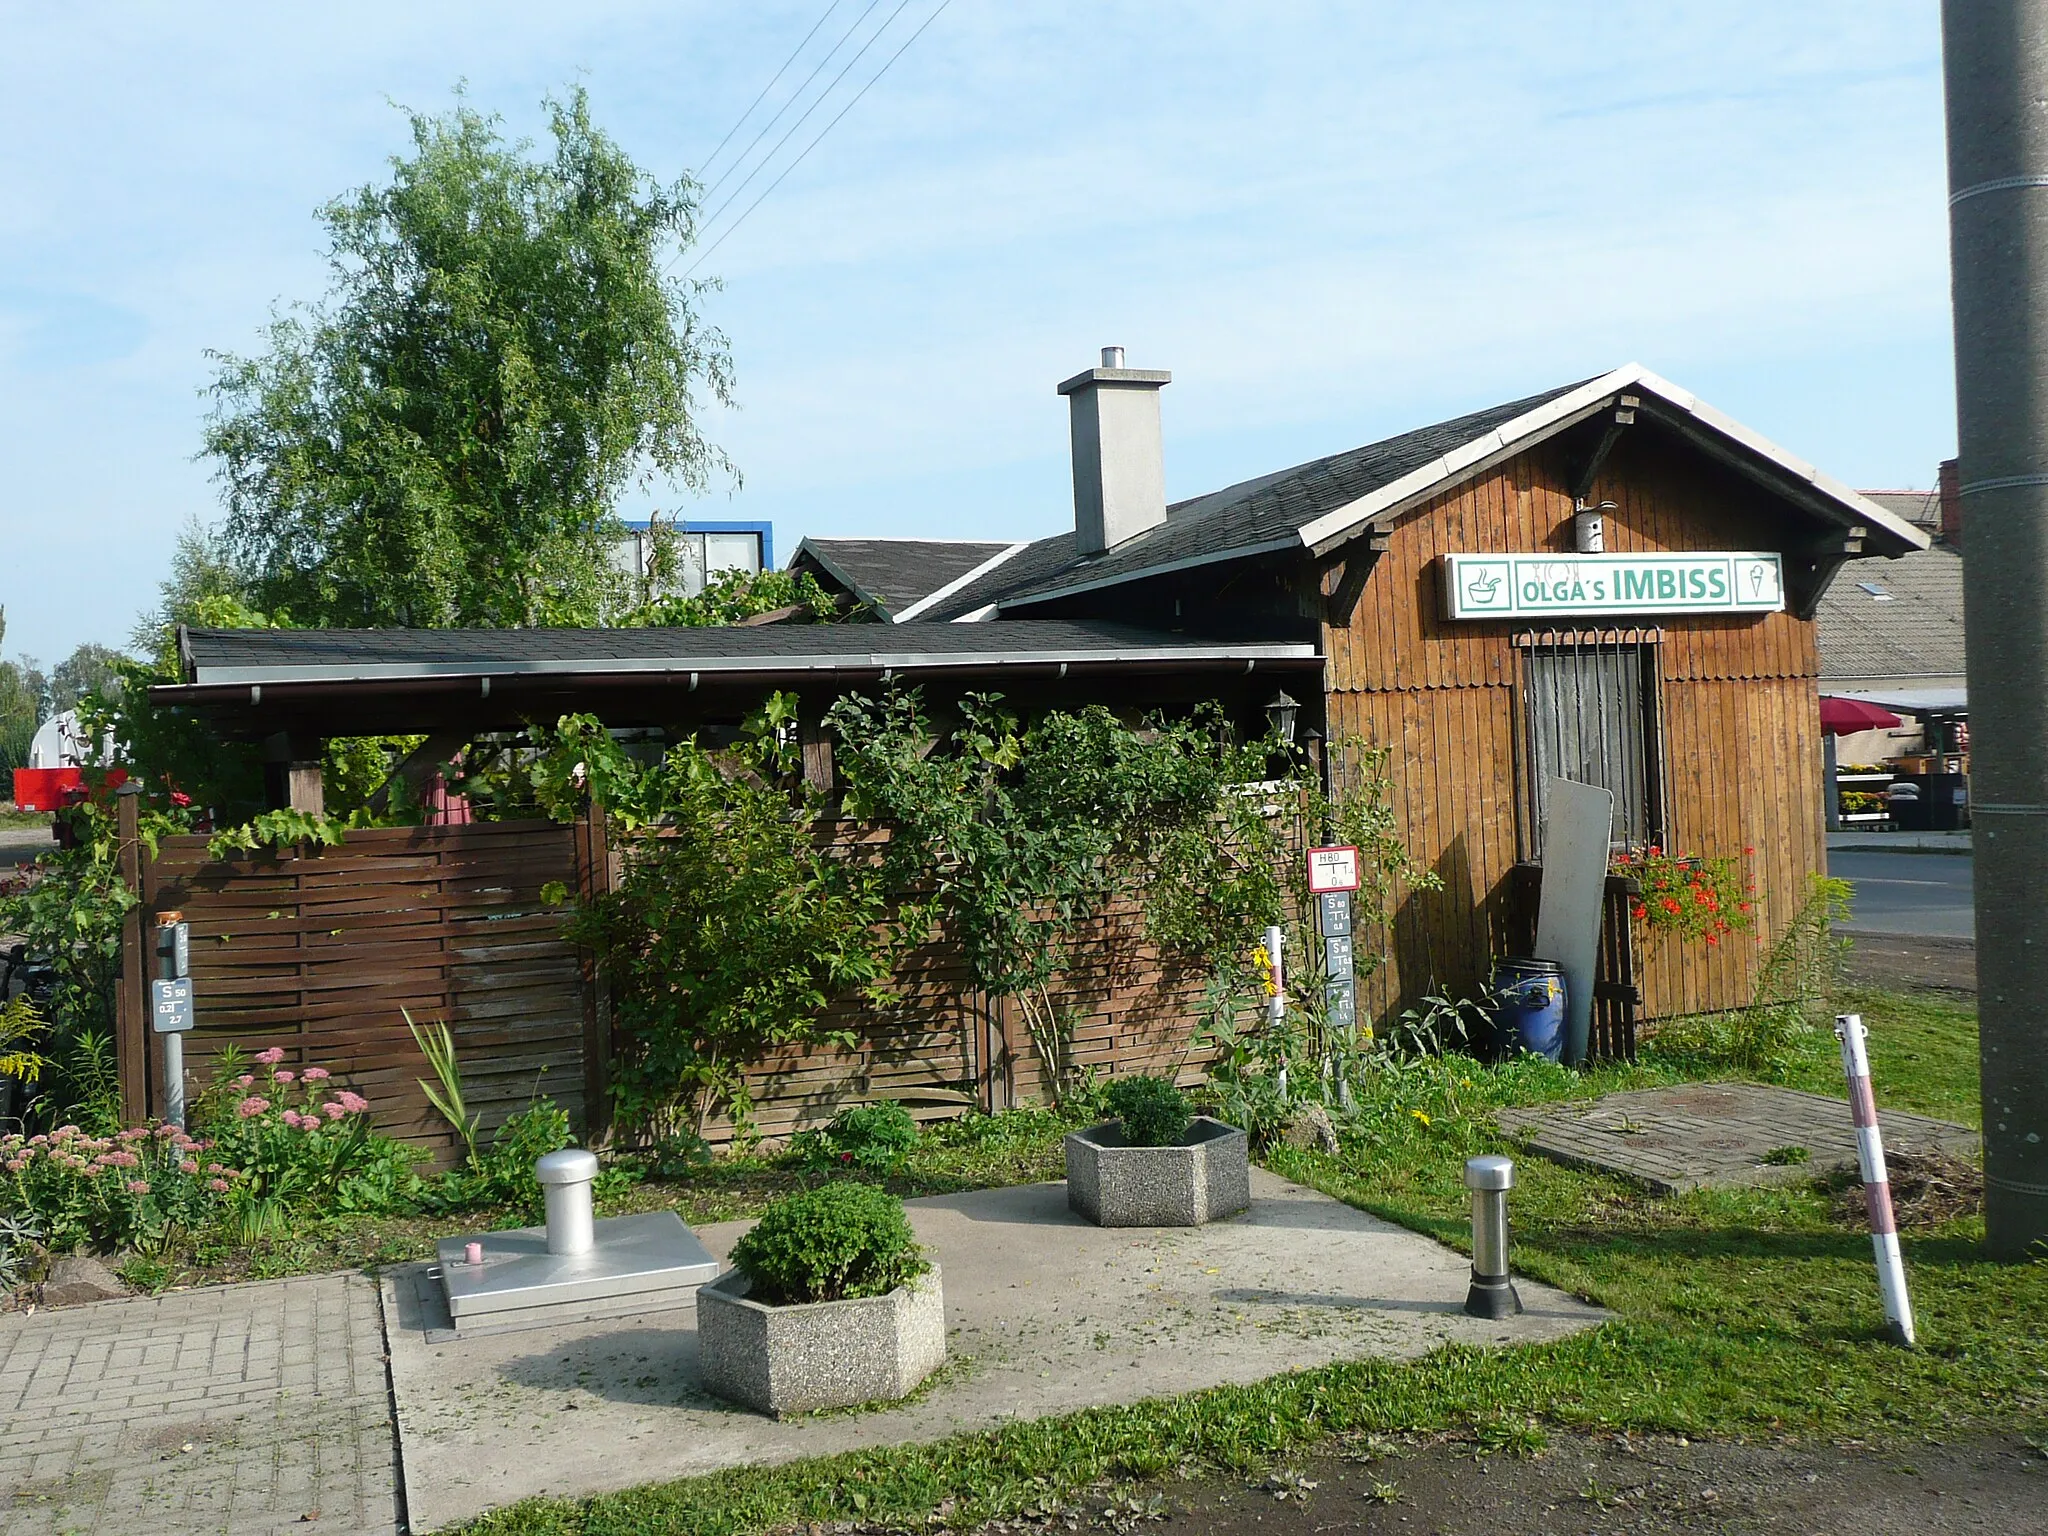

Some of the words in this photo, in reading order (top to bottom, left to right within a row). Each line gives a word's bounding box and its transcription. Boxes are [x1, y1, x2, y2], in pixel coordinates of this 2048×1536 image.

[1613, 568, 1727, 600] IMBISS
[1328, 898, 1336, 909] S
[1333, 943, 1339, 954] S
[162, 986, 172, 998] S
[174, 988, 186, 998] 50
